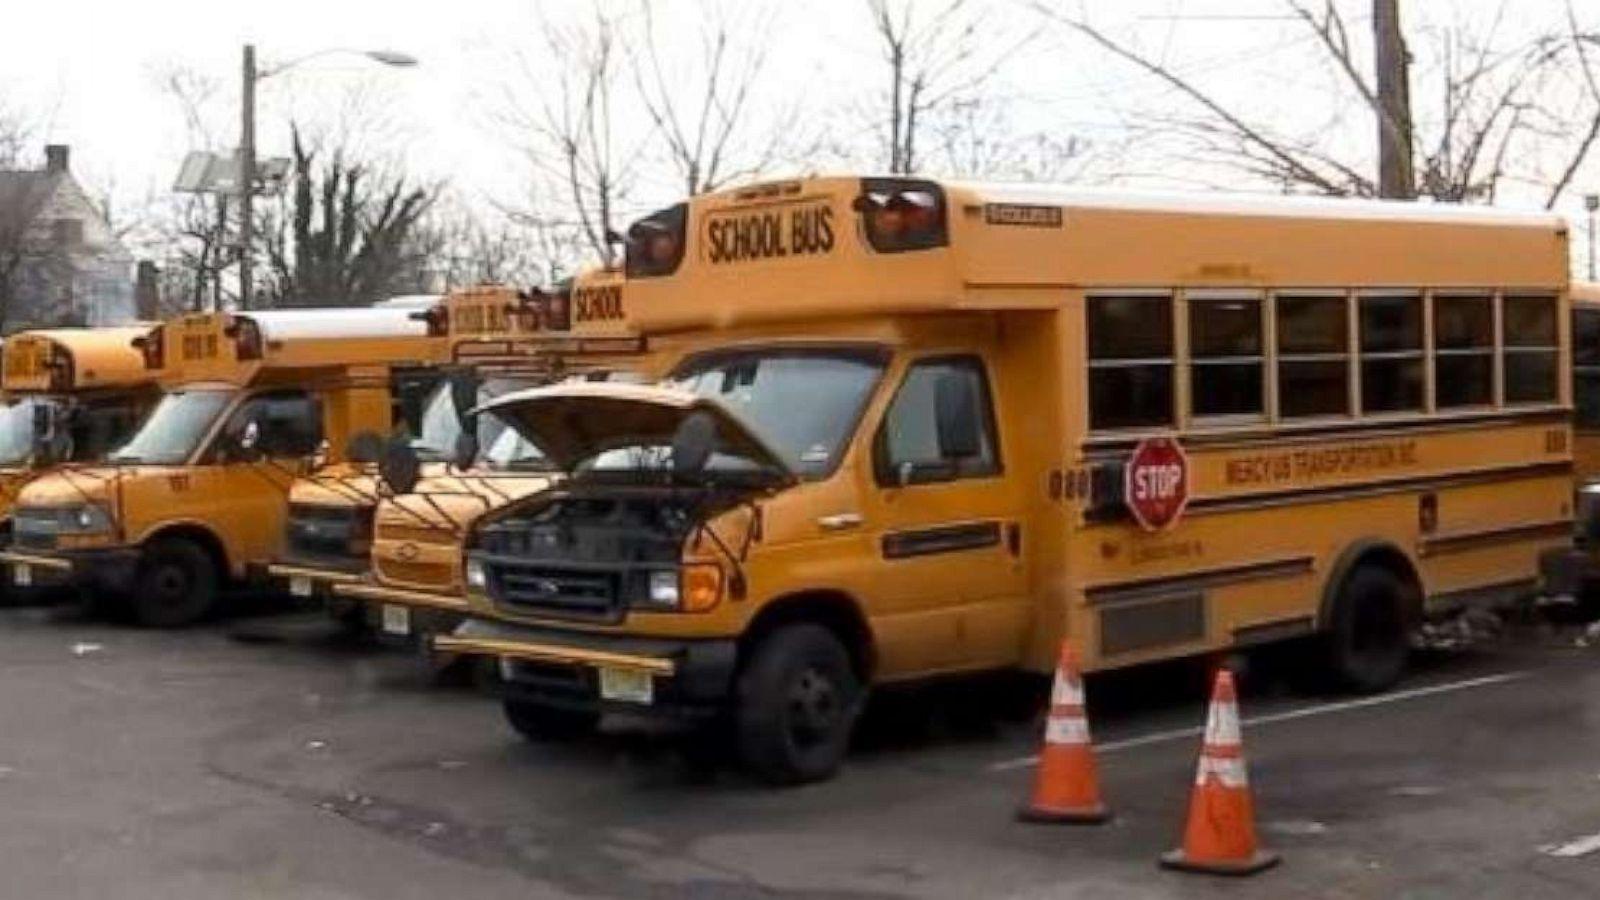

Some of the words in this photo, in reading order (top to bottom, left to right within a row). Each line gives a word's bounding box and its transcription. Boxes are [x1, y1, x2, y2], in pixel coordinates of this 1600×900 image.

[708, 213, 787, 264] SCHOOL
[792, 205, 835, 254] BUS
[575, 286, 625, 323] SCHOOL
[1135, 464, 1181, 500] STOP
